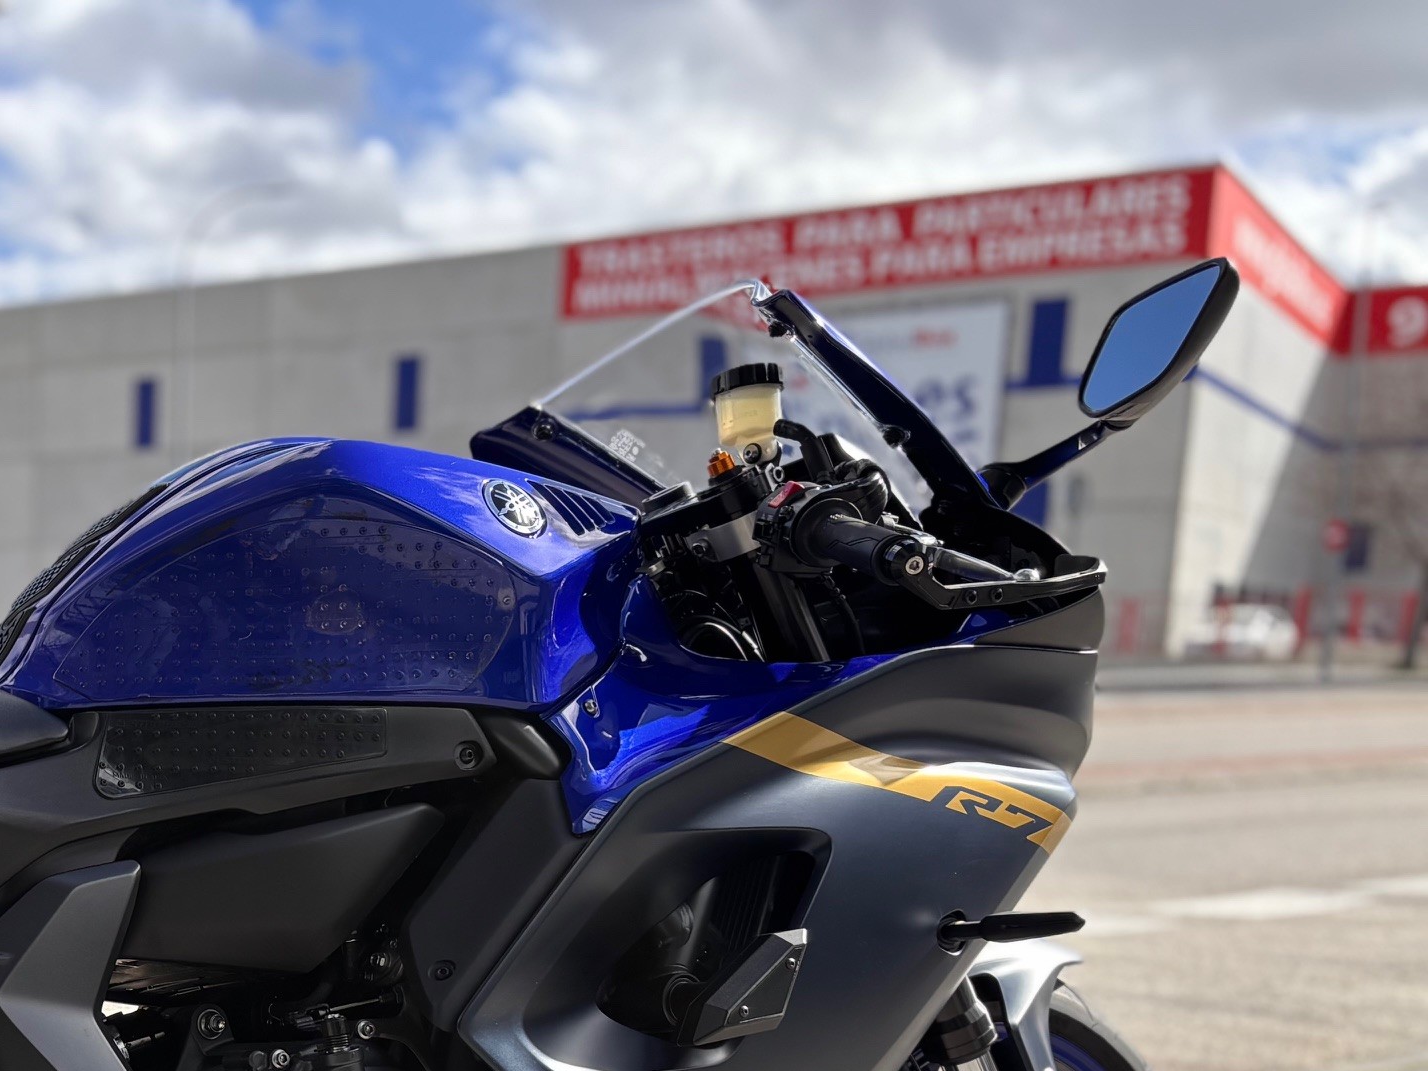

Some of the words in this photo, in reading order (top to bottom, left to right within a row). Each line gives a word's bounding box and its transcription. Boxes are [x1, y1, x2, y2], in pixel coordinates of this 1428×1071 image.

[794, 205, 902, 250] PARA
[913, 173, 1191, 237] PARTICULARES
[873, 237, 971, 283] PARA
[977, 221, 1186, 272] EMPRESAS
[932, 786, 1054, 839] R7
